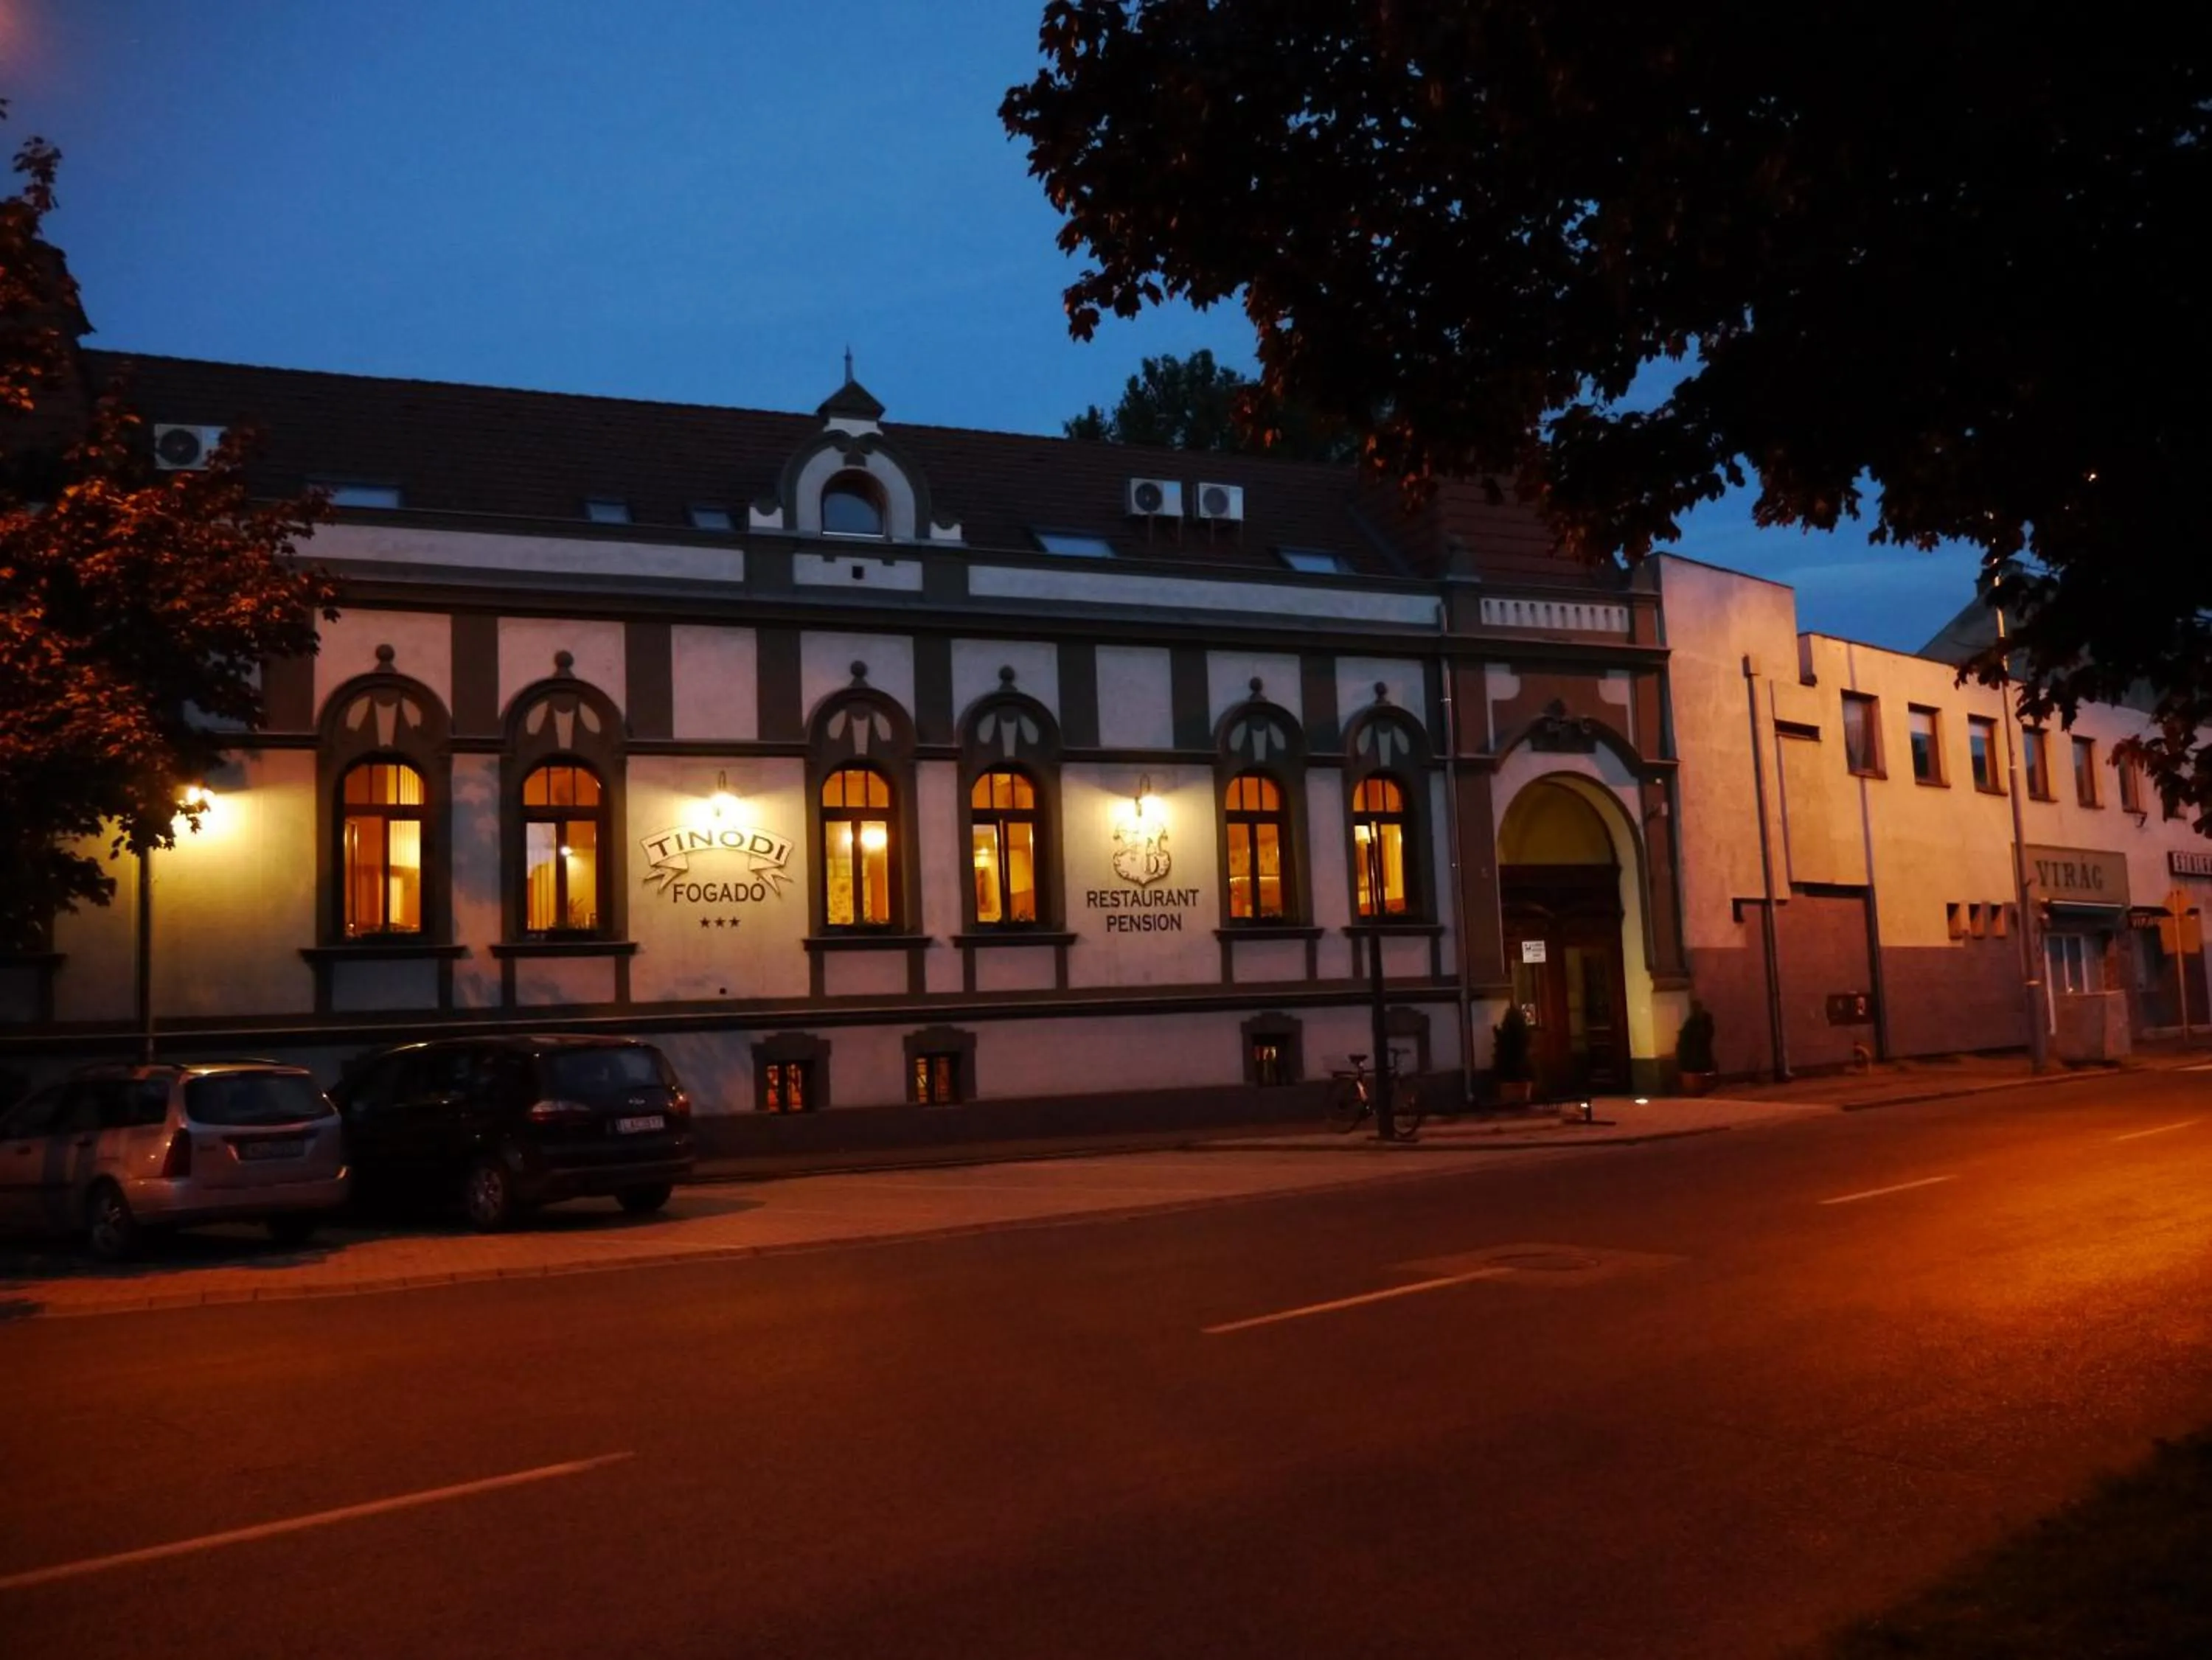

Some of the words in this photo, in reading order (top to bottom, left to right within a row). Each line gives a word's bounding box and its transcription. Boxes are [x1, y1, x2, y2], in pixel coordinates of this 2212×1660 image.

[2034, 855, 2103, 890] VIRÁG
[672, 876, 766, 904] FOGADÓ
[1086, 889, 1199, 908] RESTAURANT
[1107, 914, 1182, 932] PENSION
